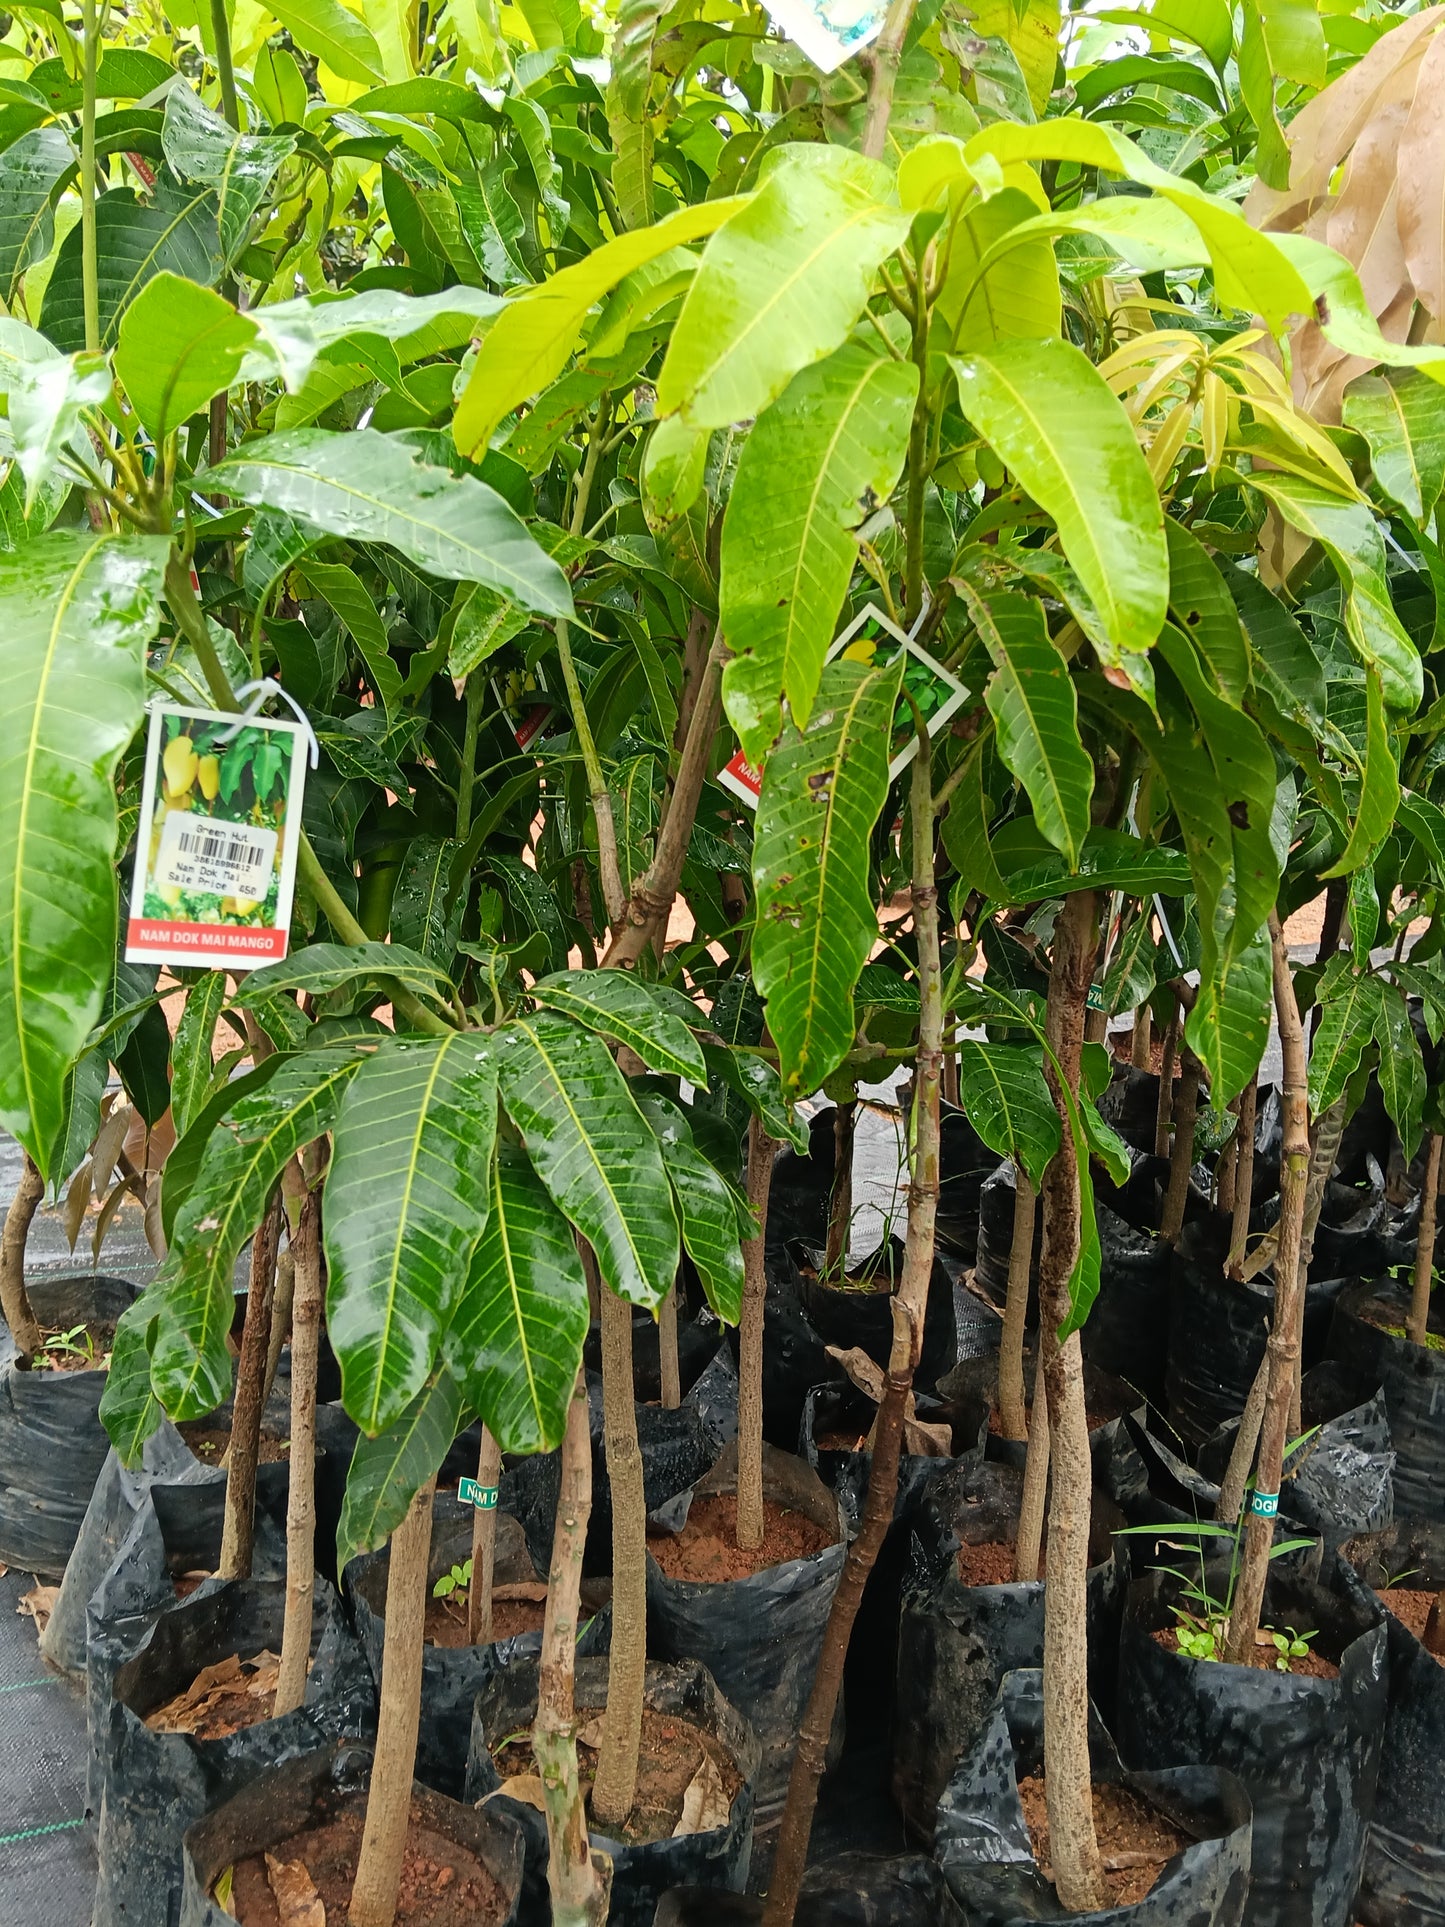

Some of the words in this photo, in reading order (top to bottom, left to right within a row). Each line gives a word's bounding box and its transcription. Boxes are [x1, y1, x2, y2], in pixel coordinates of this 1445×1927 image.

[737, 762, 761, 785] NAM
[196, 824, 226, 839] Green
[231, 832, 249, 843] Hut
[176, 862, 195, 873] Nam
[200, 866, 218, 877] Dok
[223, 870, 240, 882] Mai
[168, 872, 192, 884] Sale
[198, 877, 227, 891] Price
[238, 885, 257, 896] 450
[139, 929, 170, 943] NAM
[173, 932, 199, 945] DOK
[201, 934, 225, 946] MAI
[228, 936, 274, 950] MANGO
